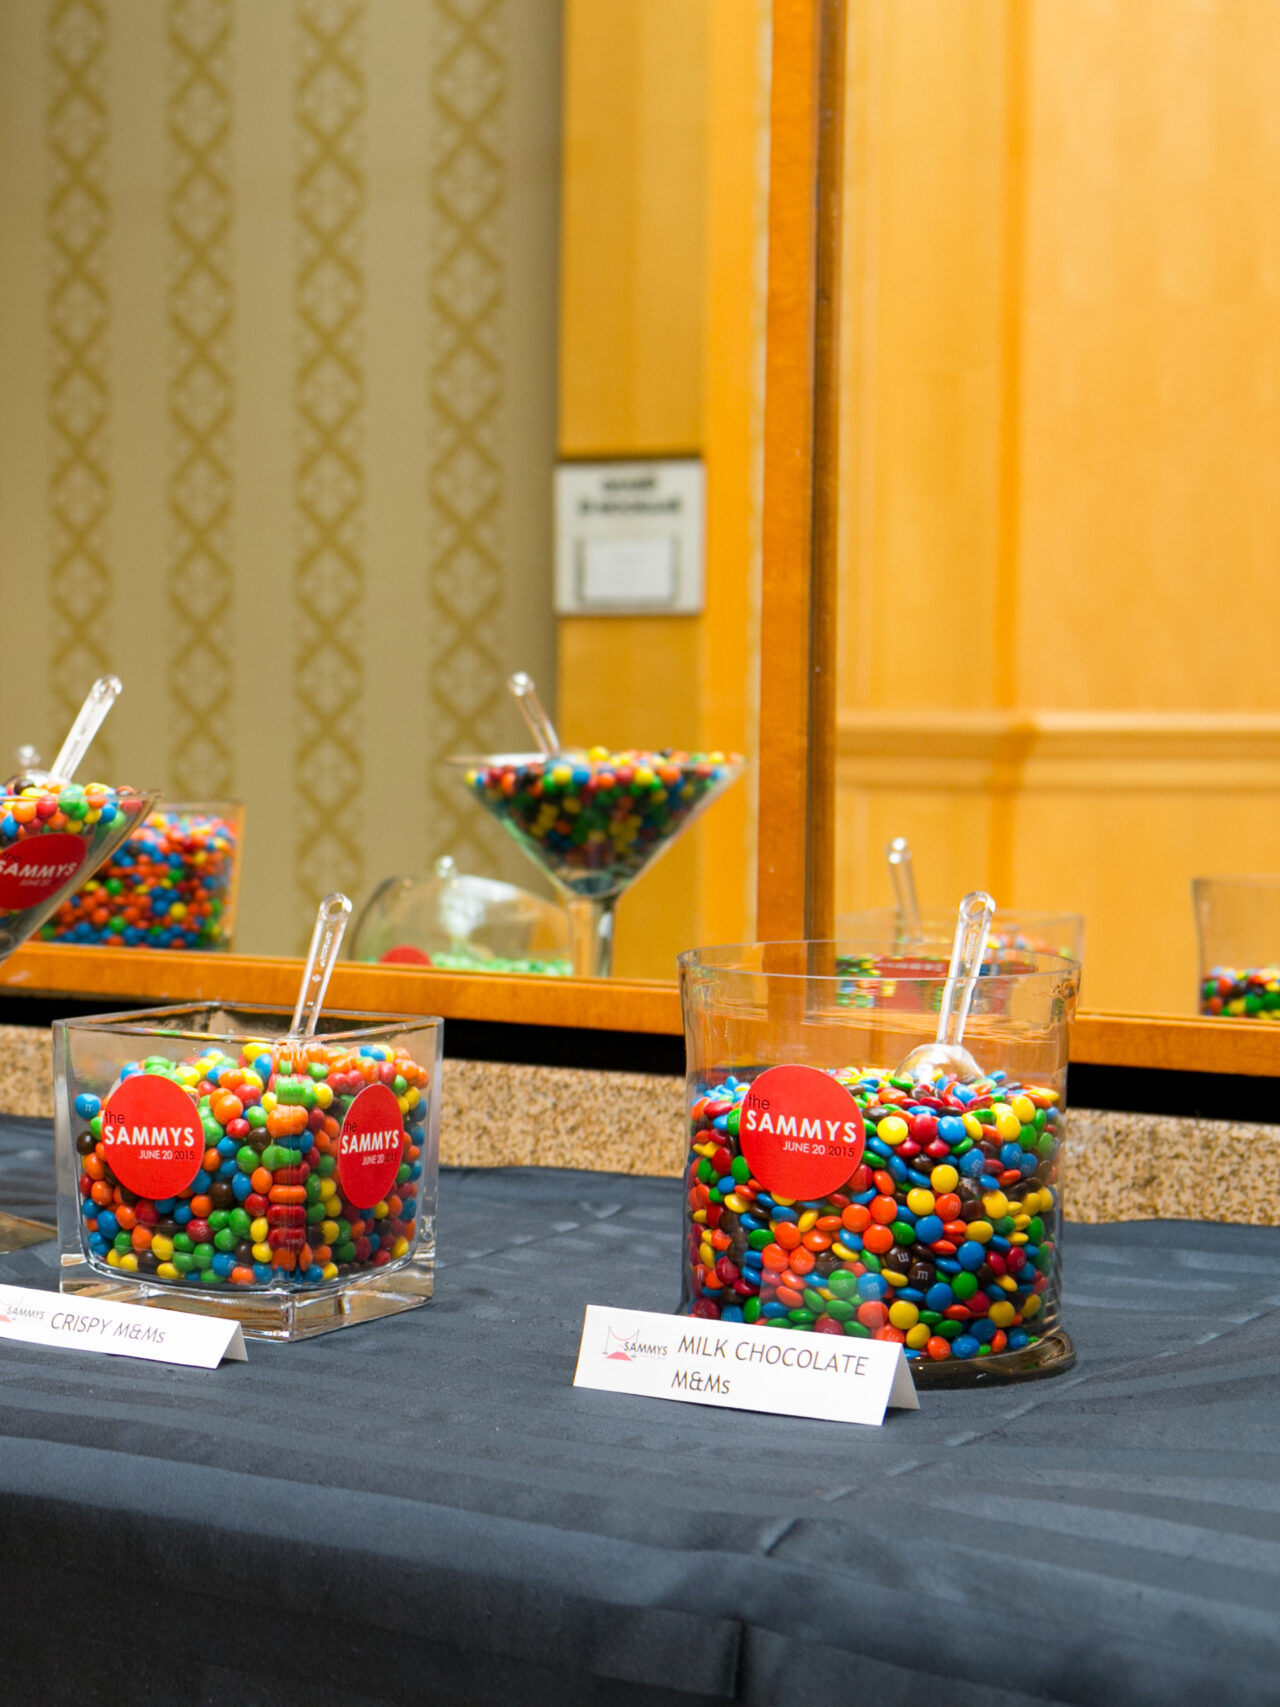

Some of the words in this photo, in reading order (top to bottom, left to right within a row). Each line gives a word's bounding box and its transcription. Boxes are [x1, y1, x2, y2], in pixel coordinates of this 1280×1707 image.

[748, 1094, 770, 1110] the
[104, 1111, 125, 1125] the
[746, 1109, 857, 1144] SAMMYS
[104, 1125, 195, 1147] SAMMYS
[341, 1129, 399, 1155] SAMMYS
[139, 1149, 160, 1160] JUNE
[162, 1150, 173, 1160] 20
[782, 1140, 809, 1154] JUNE
[811, 1143, 826, 1155] 20
[828, 1145, 855, 1157] 2015
[6, 1305, 45, 1320] SAMMYS
[50, 1312, 113, 1335] CRISPY
[113, 1321, 167, 1344] M&Ms
[623, 1340, 668, 1356] SAMMYS
[677, 1334, 729, 1359] MILK
[734, 1340, 870, 1377] CHOCOLATE
[671, 1369, 731, 1395] M&Ms
